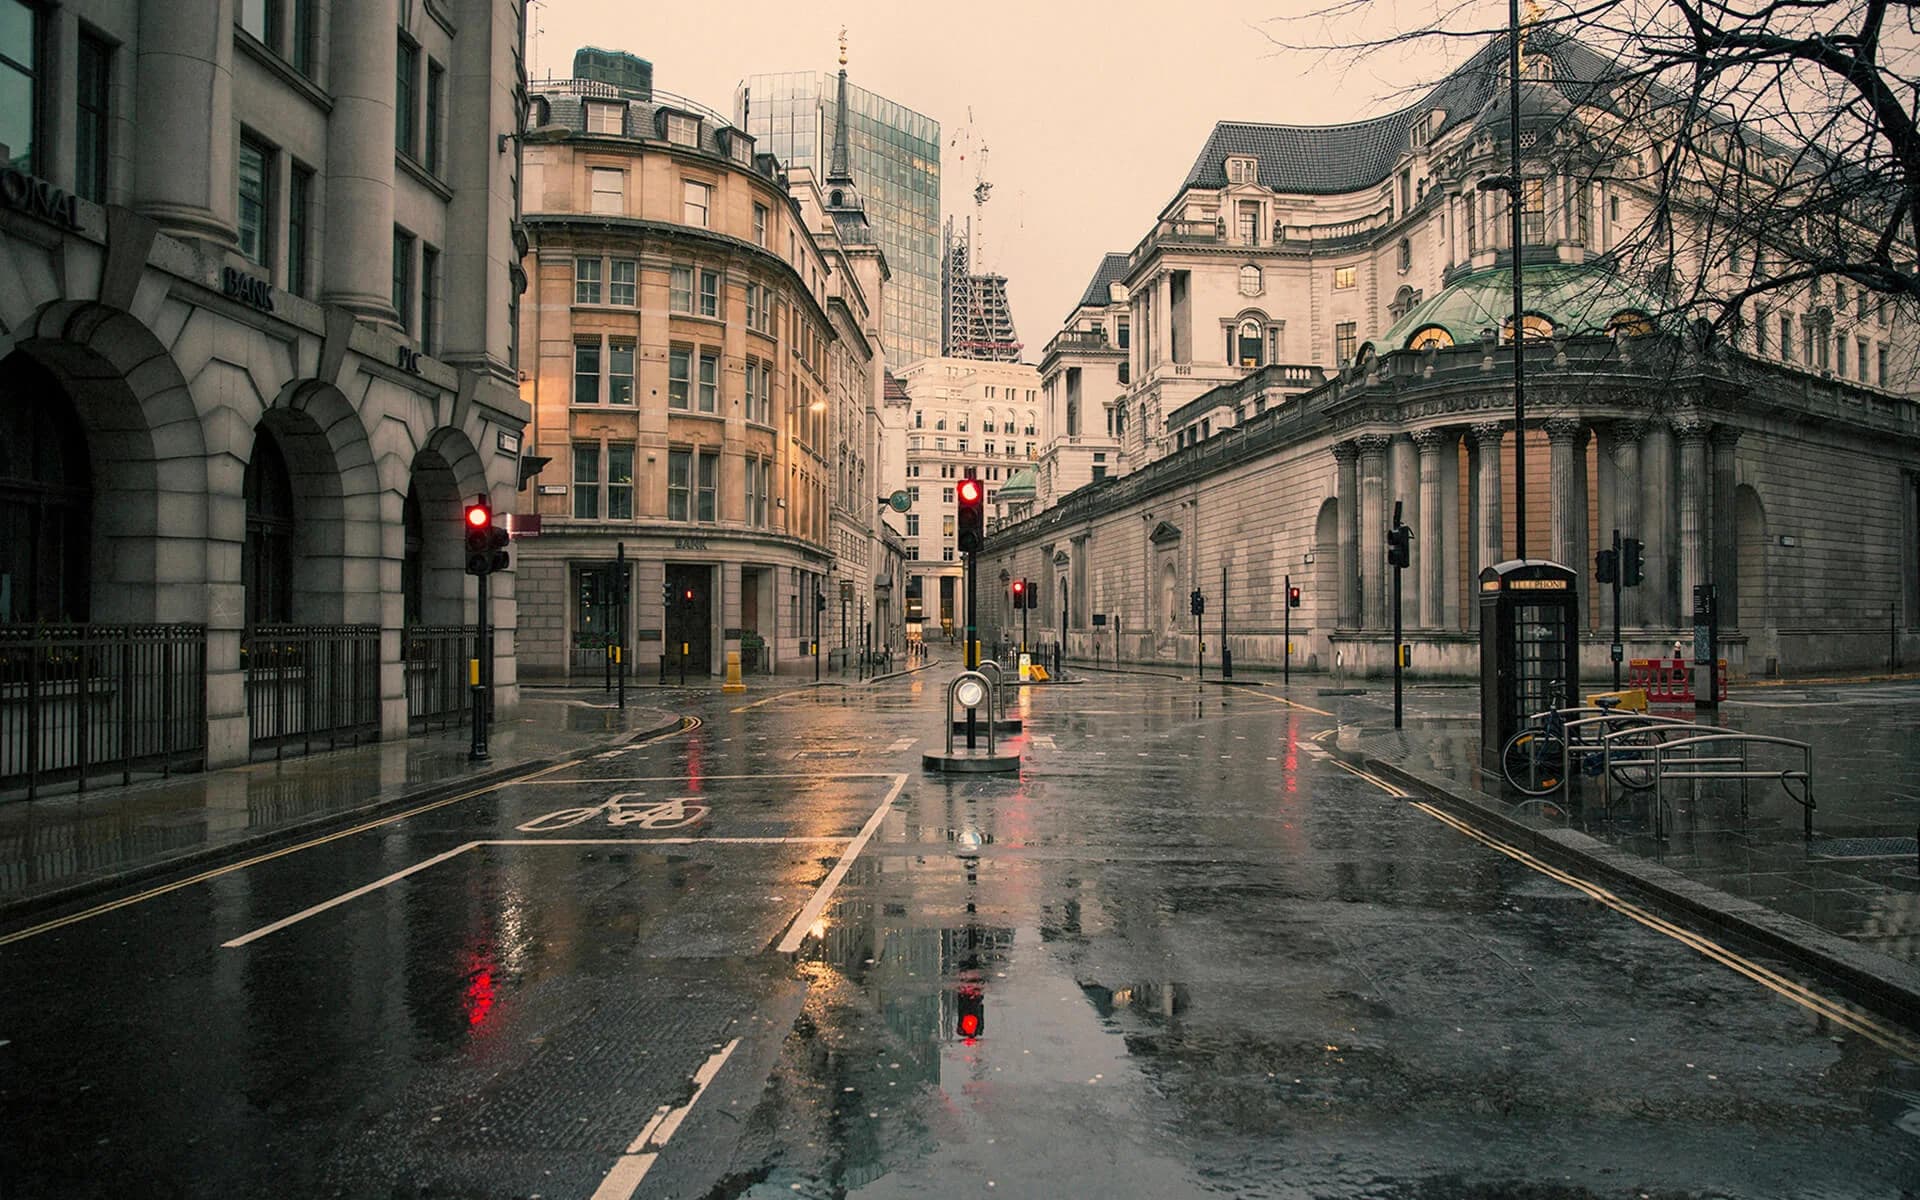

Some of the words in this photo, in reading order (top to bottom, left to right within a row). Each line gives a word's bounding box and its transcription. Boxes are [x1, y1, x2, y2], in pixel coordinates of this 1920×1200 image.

[223, 266, 274, 312] BANK
[398, 345, 421, 374] PLC
[675, 536, 708, 550] BANK
[1511, 580, 1566, 590] TELEPHONE
